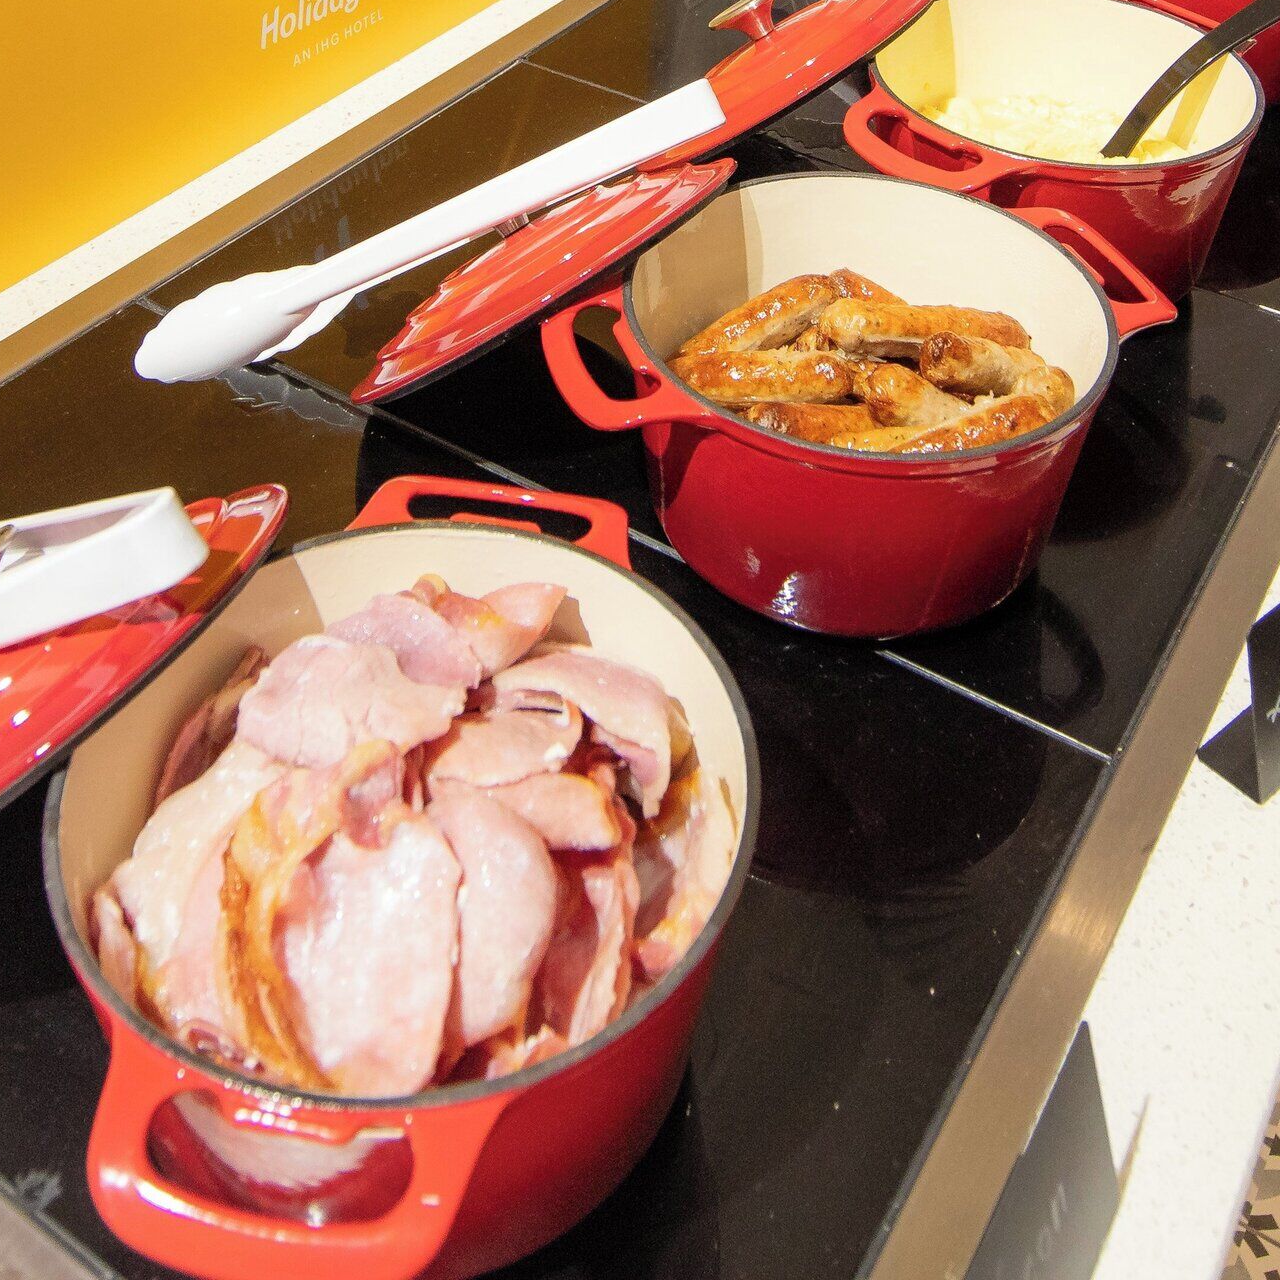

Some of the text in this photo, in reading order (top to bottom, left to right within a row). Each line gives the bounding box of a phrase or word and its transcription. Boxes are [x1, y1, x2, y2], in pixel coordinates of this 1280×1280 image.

[293, 8, 384, 68] AN IHG HOTEL
